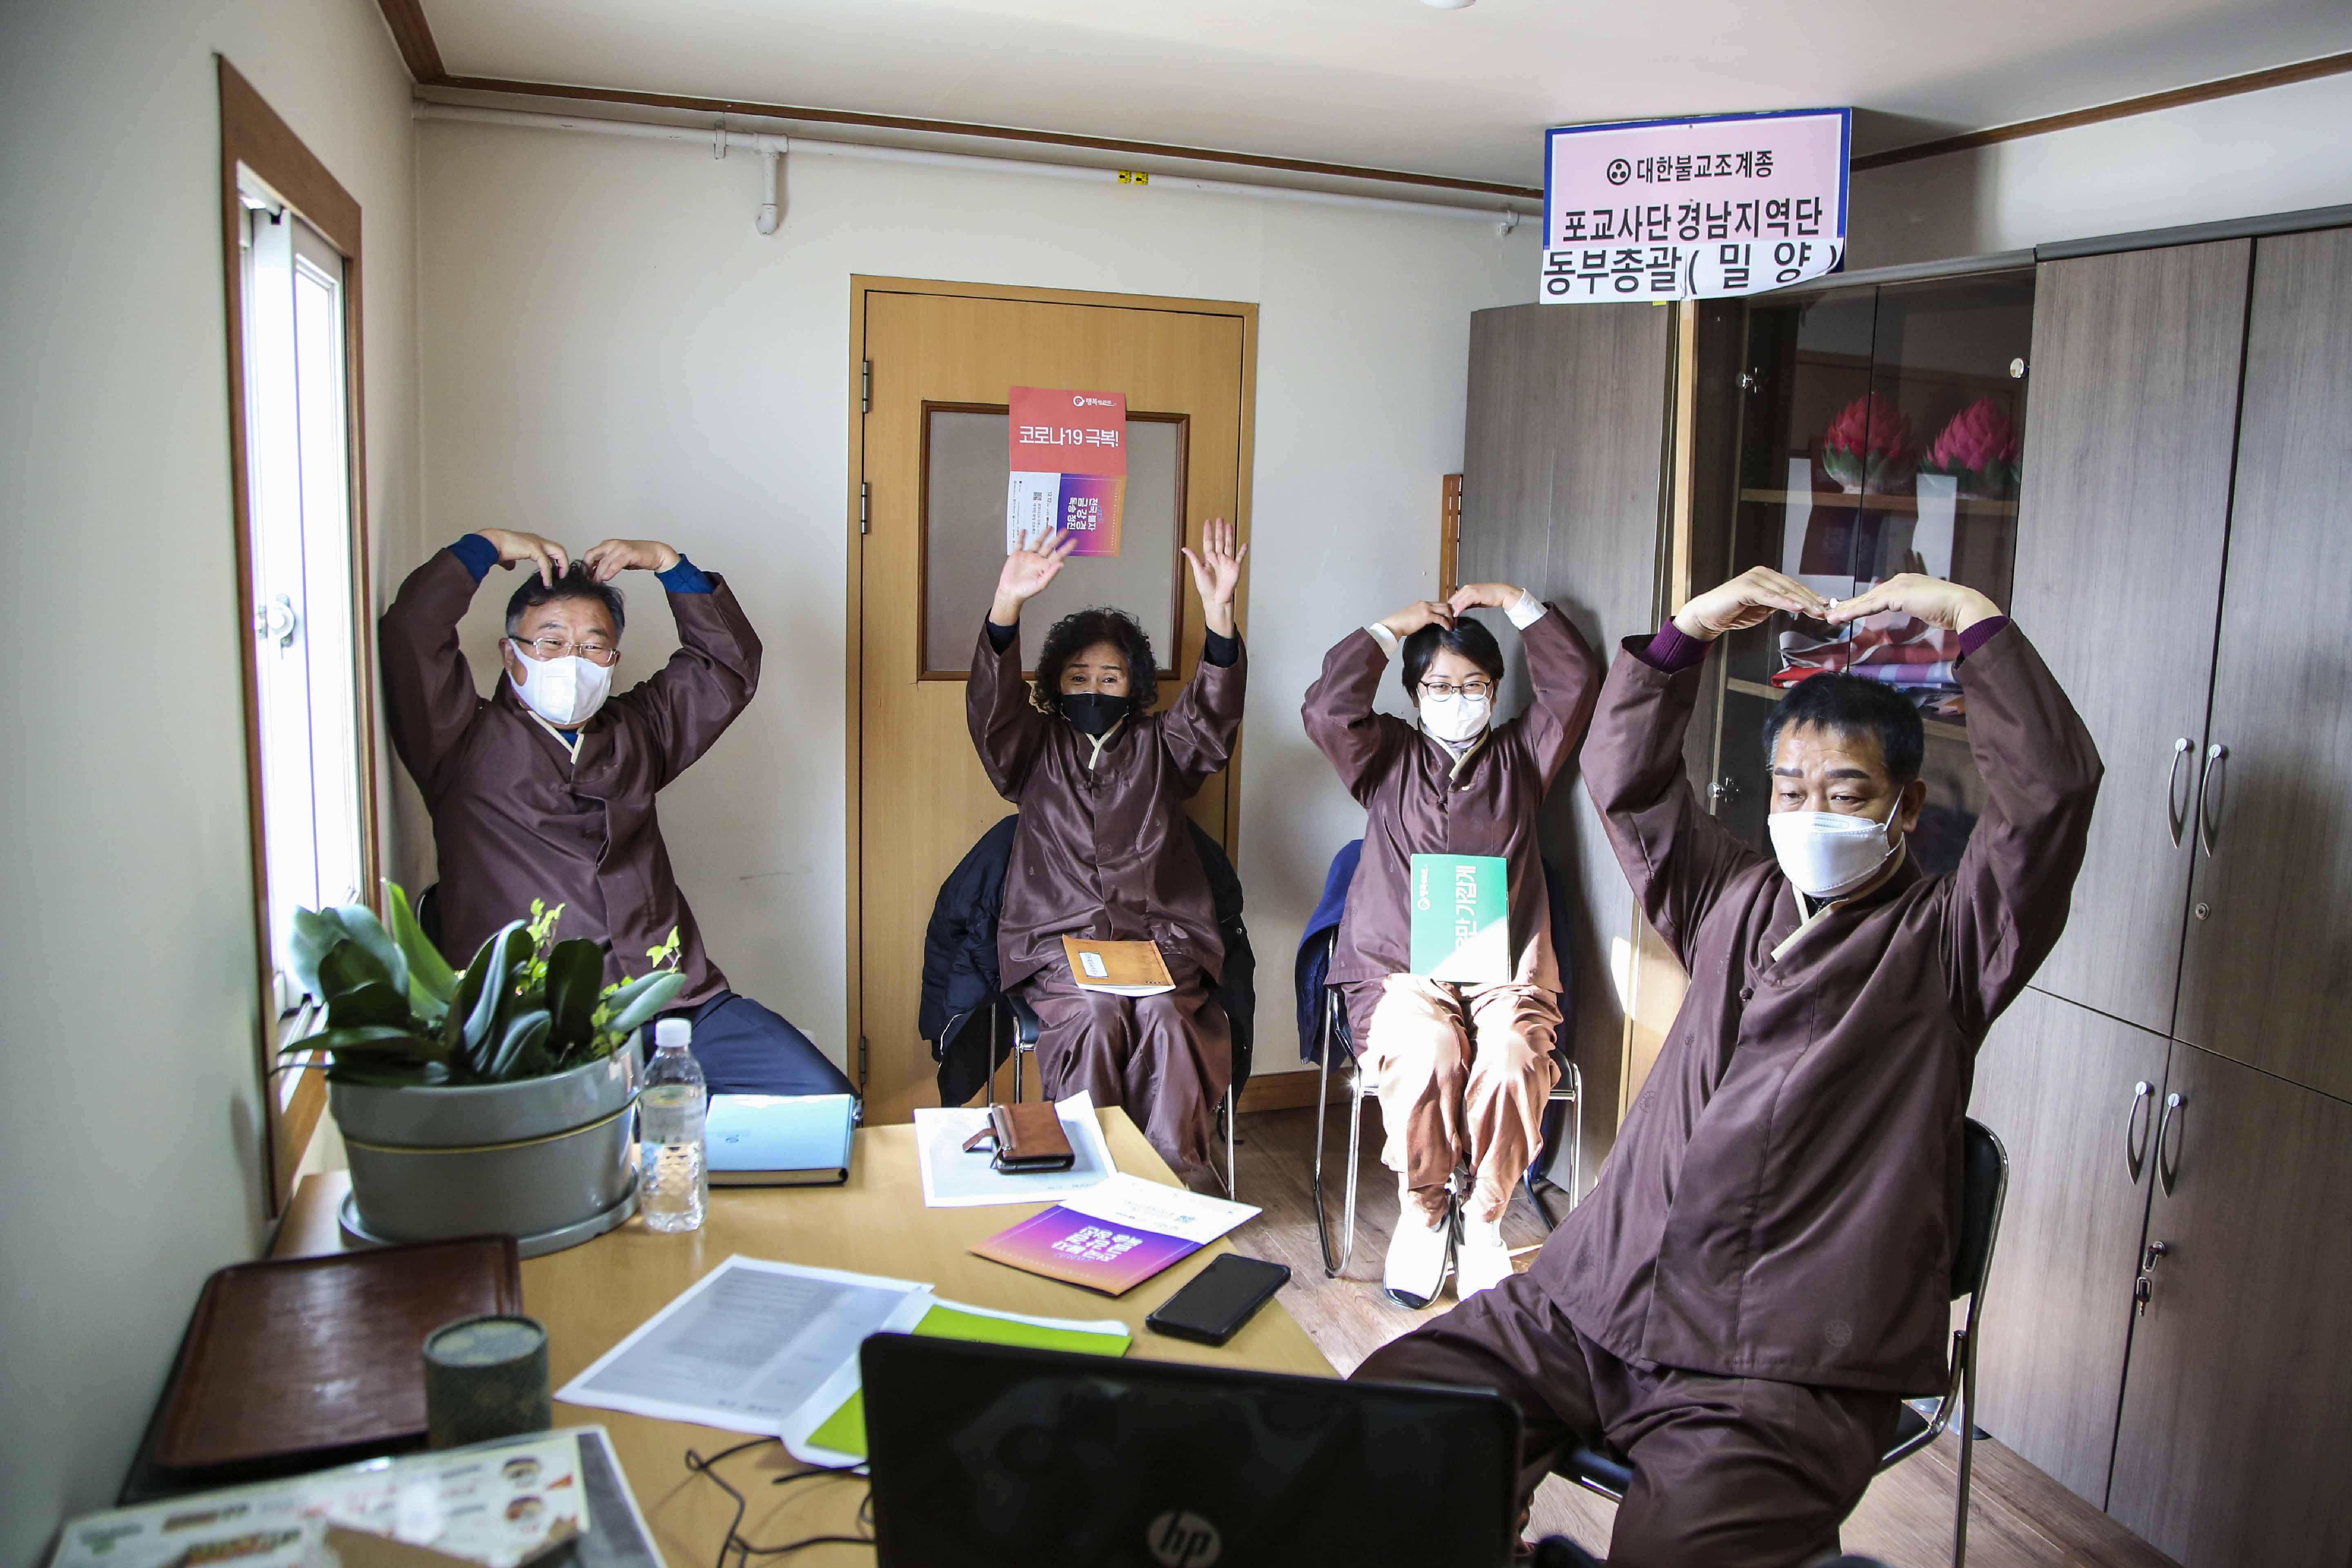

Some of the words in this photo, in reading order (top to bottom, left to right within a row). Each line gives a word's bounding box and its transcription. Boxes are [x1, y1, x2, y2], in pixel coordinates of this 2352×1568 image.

[1637, 149, 1773, 184] 대한불교조계종
[1019, 425, 1083, 445] 코로나19
[1085, 428, 1119, 447] 극복!
[1067, 514, 1076, 530] 정진
[1455, 865, 1477, 916] 가깝게
[1159, 1510, 1213, 1568] hp
